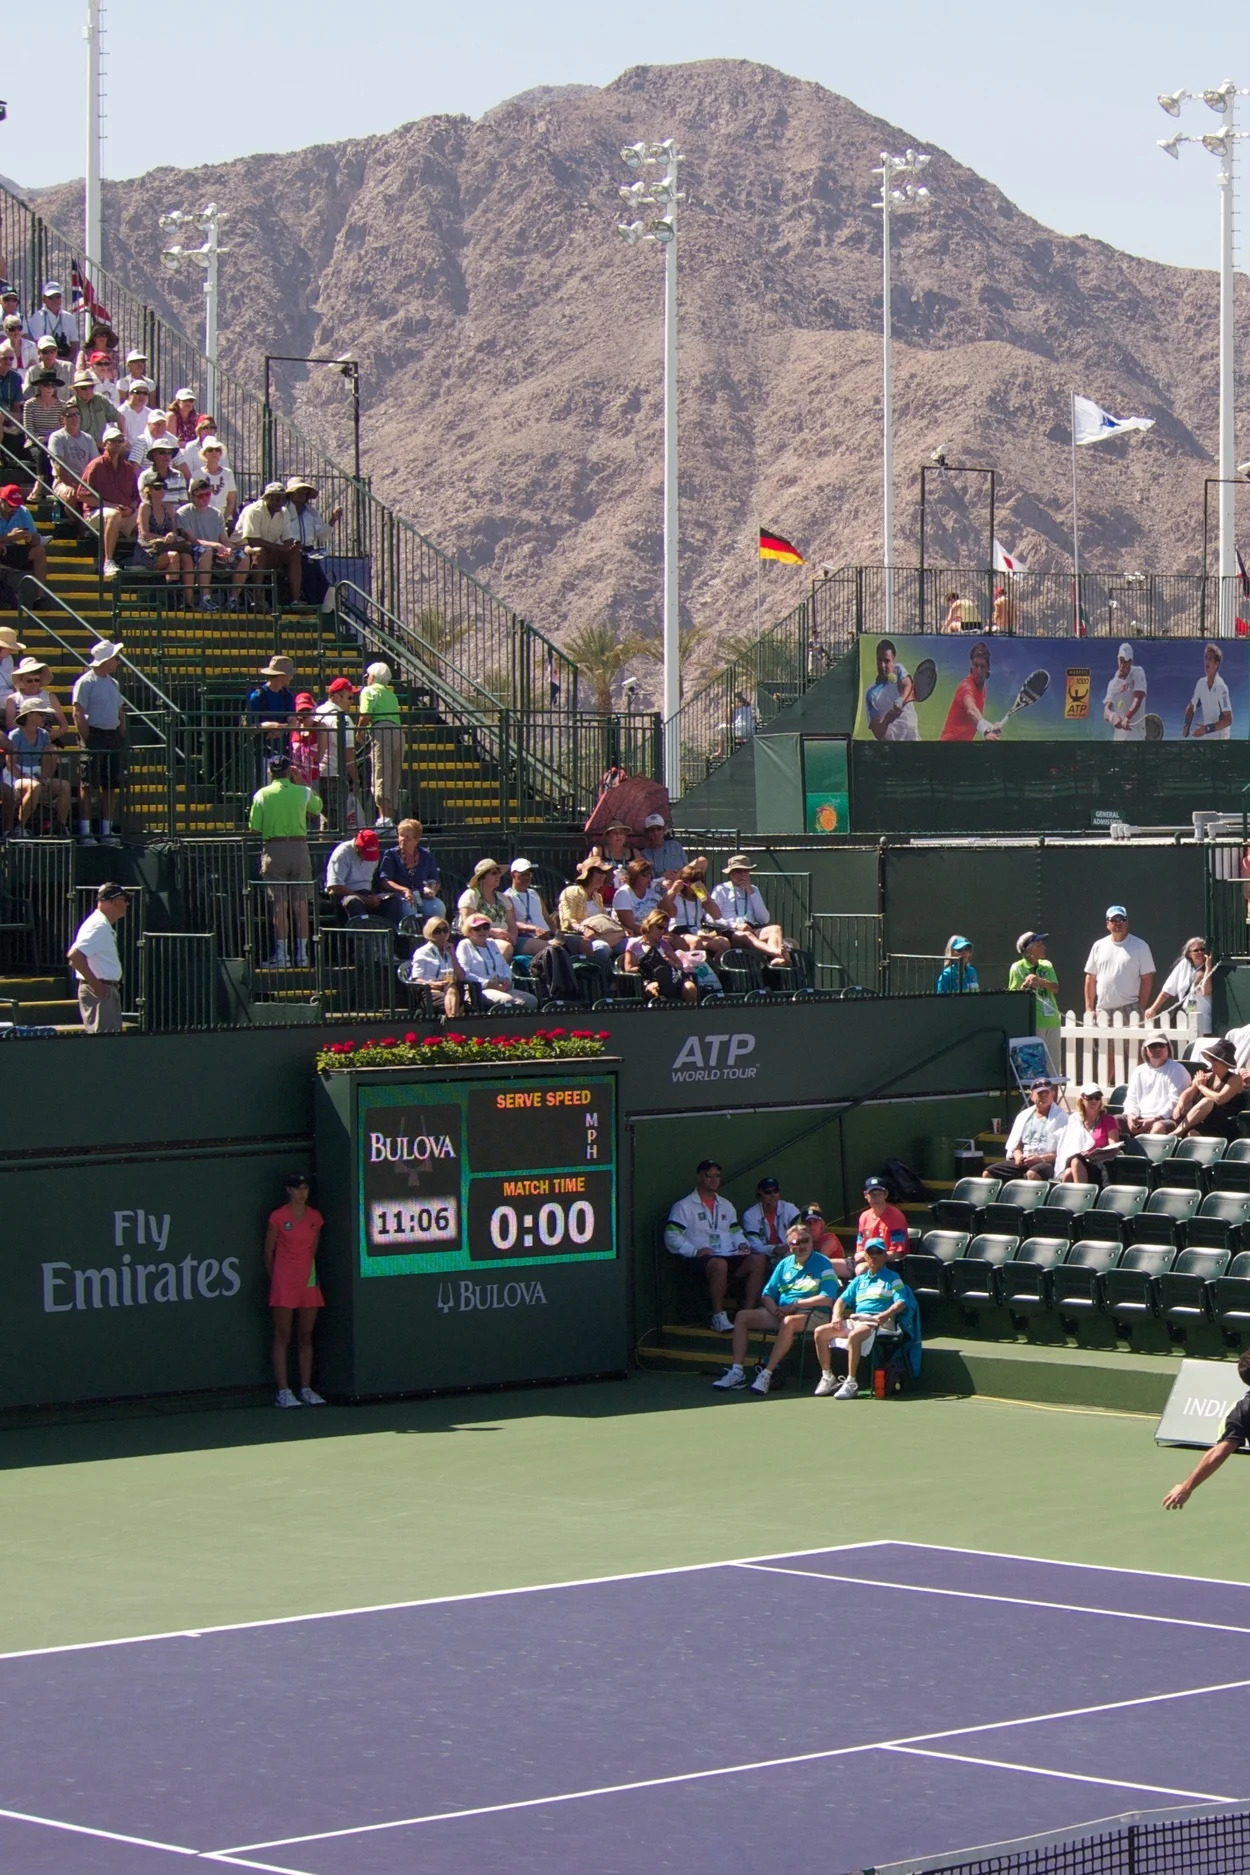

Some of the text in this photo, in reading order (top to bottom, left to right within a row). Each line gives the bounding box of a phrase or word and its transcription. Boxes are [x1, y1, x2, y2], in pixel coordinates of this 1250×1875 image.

[1067, 704, 1088, 713] ATP
[1095, 810, 1120, 818] GENERAL
[672, 1033, 756, 1069] ATP
[672, 1067, 757, 1082] WORLD TOUR
[496, 1090, 592, 1109] SERVE SPEED
[369, 1131, 457, 1162] BULOVA
[503, 1177, 586, 1197] MATCH TIME
[114, 1208, 171, 1252] Fly
[377, 1207, 450, 1235] 11:06
[490, 1200, 595, 1249] 0:00
[41, 1253, 241, 1312] Emirates
[458, 1280, 548, 1311] BULOVA
[1182, 1397, 1228, 1418] INDI
